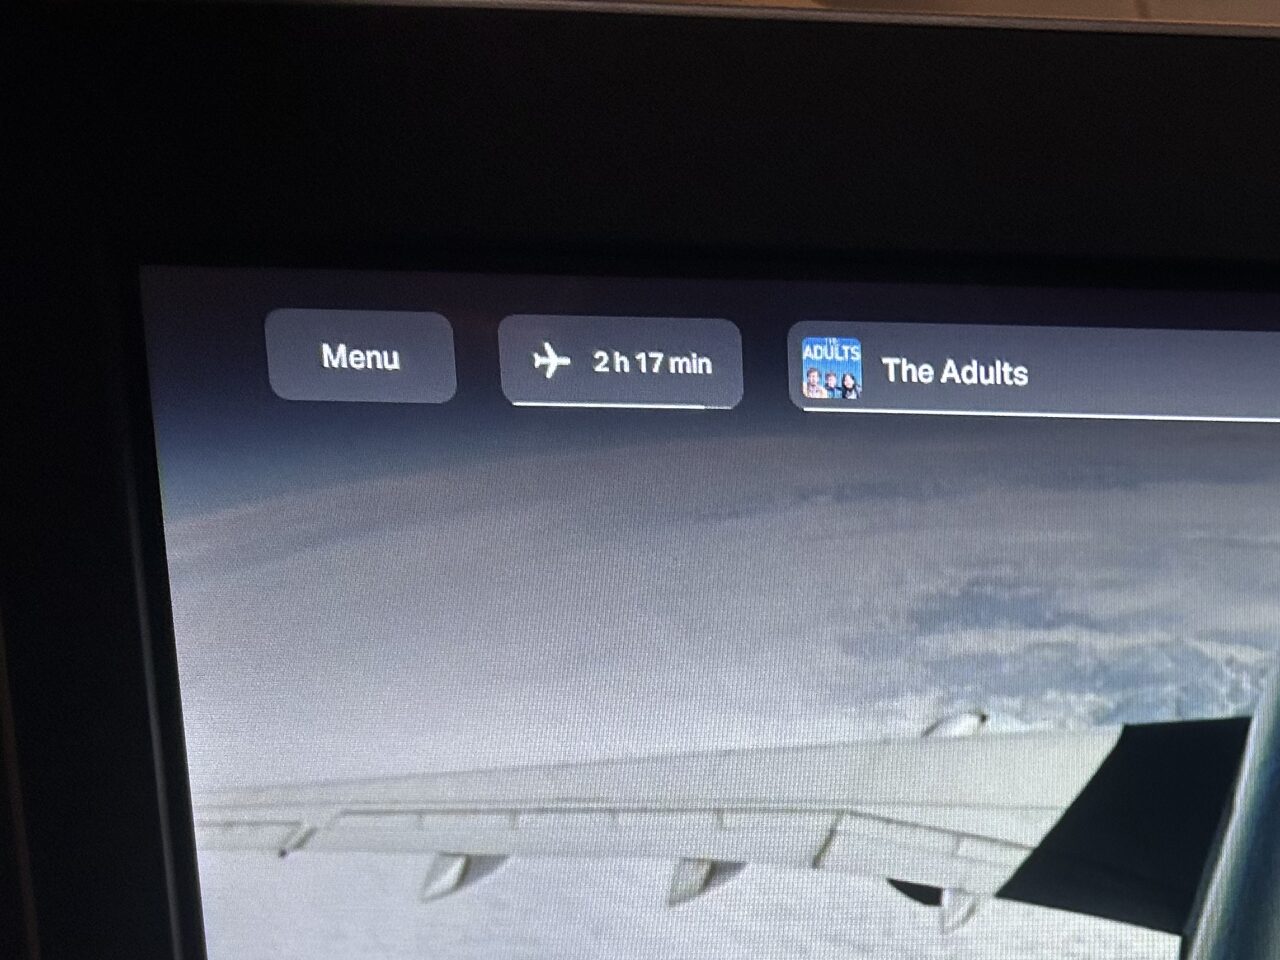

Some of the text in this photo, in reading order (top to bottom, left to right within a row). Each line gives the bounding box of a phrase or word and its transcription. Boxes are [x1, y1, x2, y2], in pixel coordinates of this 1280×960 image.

[321, 342, 401, 371] Menu
[593, 351, 713, 375] 2 h 17 min
[803, 343, 860, 362] ADULTS
[882, 357, 1029, 387] The Adults
